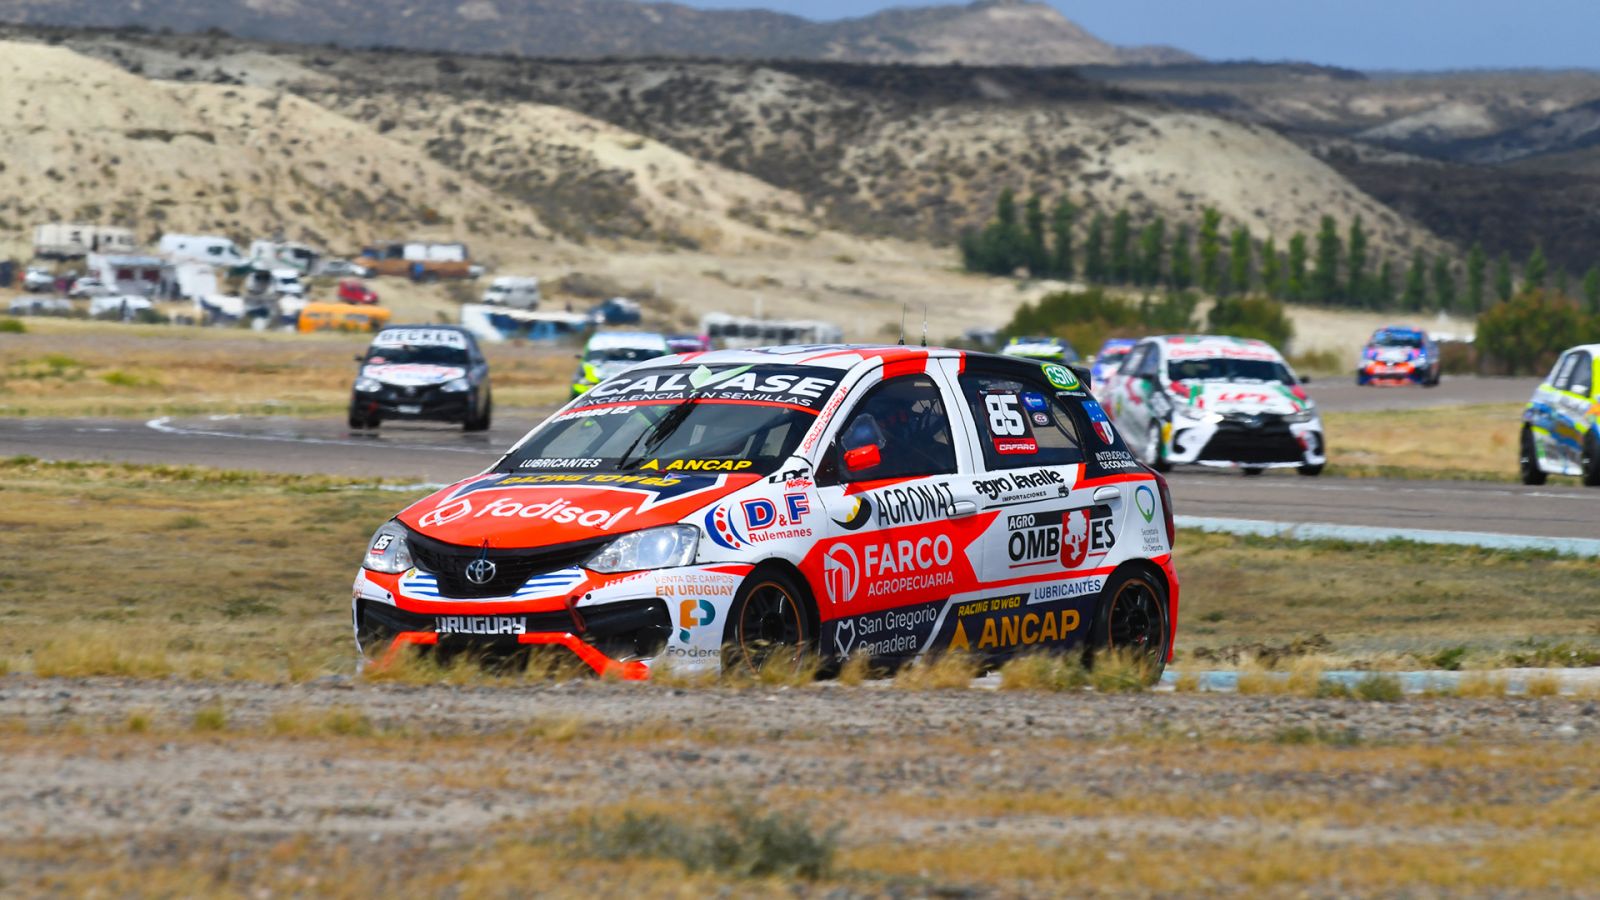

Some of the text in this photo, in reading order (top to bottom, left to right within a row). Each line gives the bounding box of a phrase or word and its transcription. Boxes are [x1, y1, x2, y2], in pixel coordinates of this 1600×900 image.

[1045, 364, 1077, 386] CSM
[580, 391, 684, 407] XCELENCIA
[719, 391, 814, 407] SEMILLAS
[984, 393, 1026, 436] 85
[999, 443, 1036, 451] CAFARO
[519, 458, 603, 469] LUBRICANTES
[666, 458, 753, 471] ANCAP
[496, 473, 588, 486] RACING
[972, 469, 1065, 501] agro lavalle
[873, 481, 957, 526] AGRONAT
[1002, 490, 1047, 502] IMPORTACIONES
[473, 497, 634, 531] fadisol
[1009, 513, 1036, 529] AGRO
[748, 527, 813, 543] Rulemanes
[864, 533, 953, 578] FARCO
[653, 574, 683, 584] VENTA
[686, 574, 698, 583] DE
[698, 575, 734, 584] CAMPOS
[867, 570, 955, 598] AGROPECUARIA
[655, 584, 734, 598] EN URUGUAY
[1034, 579, 1102, 601] LUBRICANTES
[957, 599, 988, 617] RACING
[434, 616, 527, 635] URUGUAY
[858, 604, 937, 636] San Gregorio
[977, 608, 1081, 650] ANCAP
[857, 633, 917, 657] Ganadera
